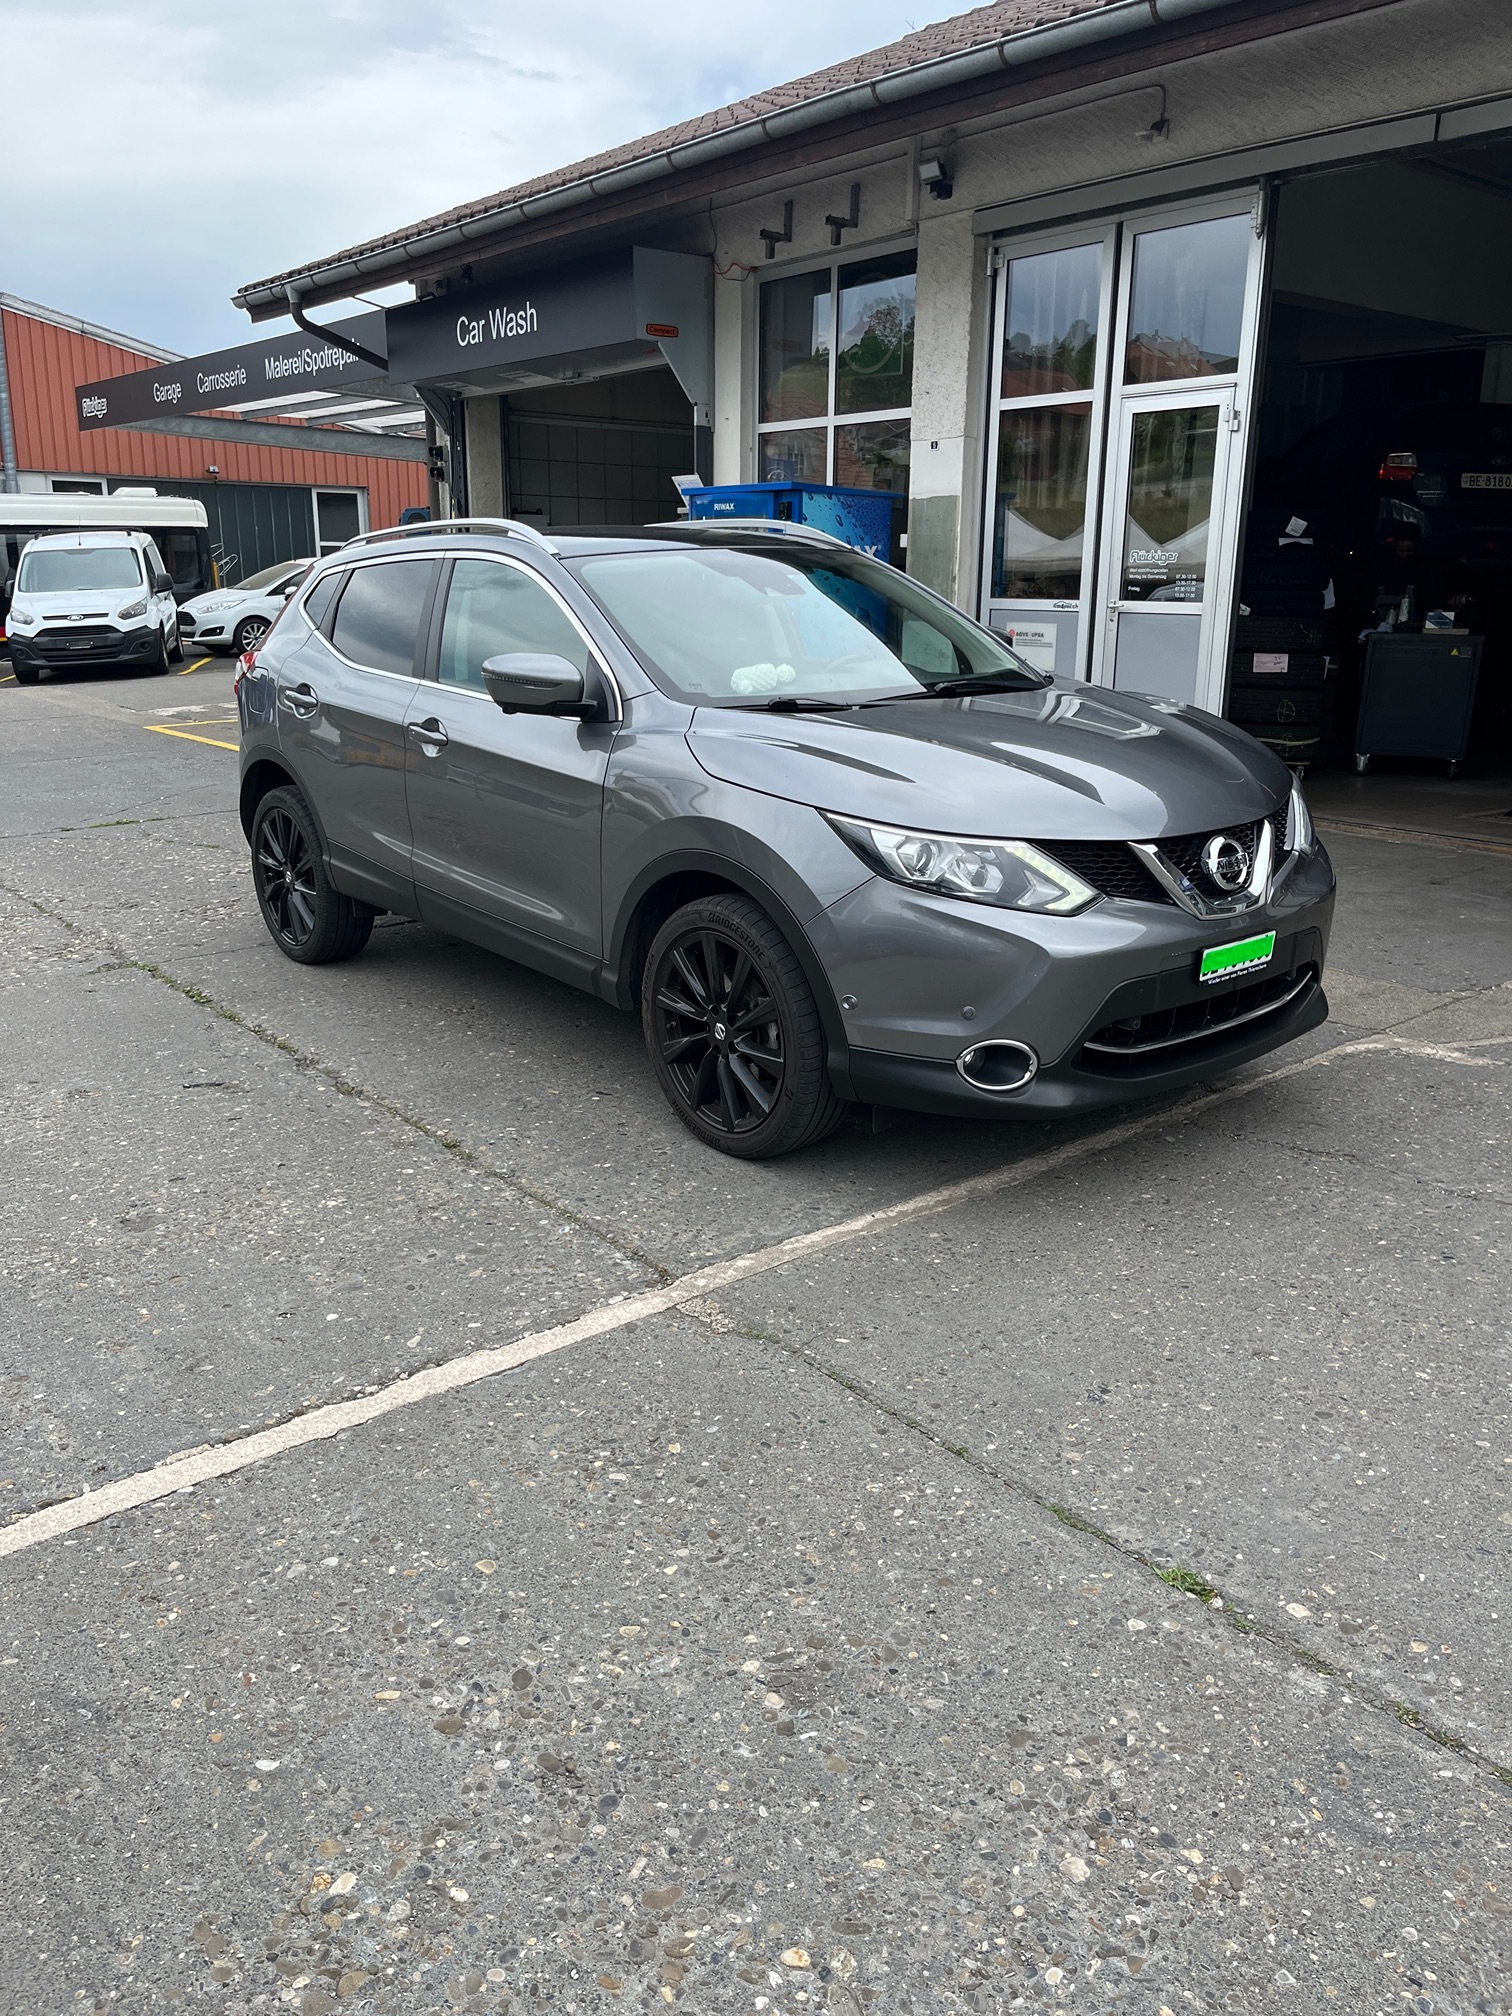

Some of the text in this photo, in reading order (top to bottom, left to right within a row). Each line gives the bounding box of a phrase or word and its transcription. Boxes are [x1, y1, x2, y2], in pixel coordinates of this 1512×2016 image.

[456, 301, 538, 347] Car Wash
[649, 326, 676, 335] Compact
[196, 364, 247, 394] Carrosserie
[153, 381, 182, 404] Garage
[713, 502, 736, 511] RIWAX
[708, 912, 766, 960] BRIDGESTONE
